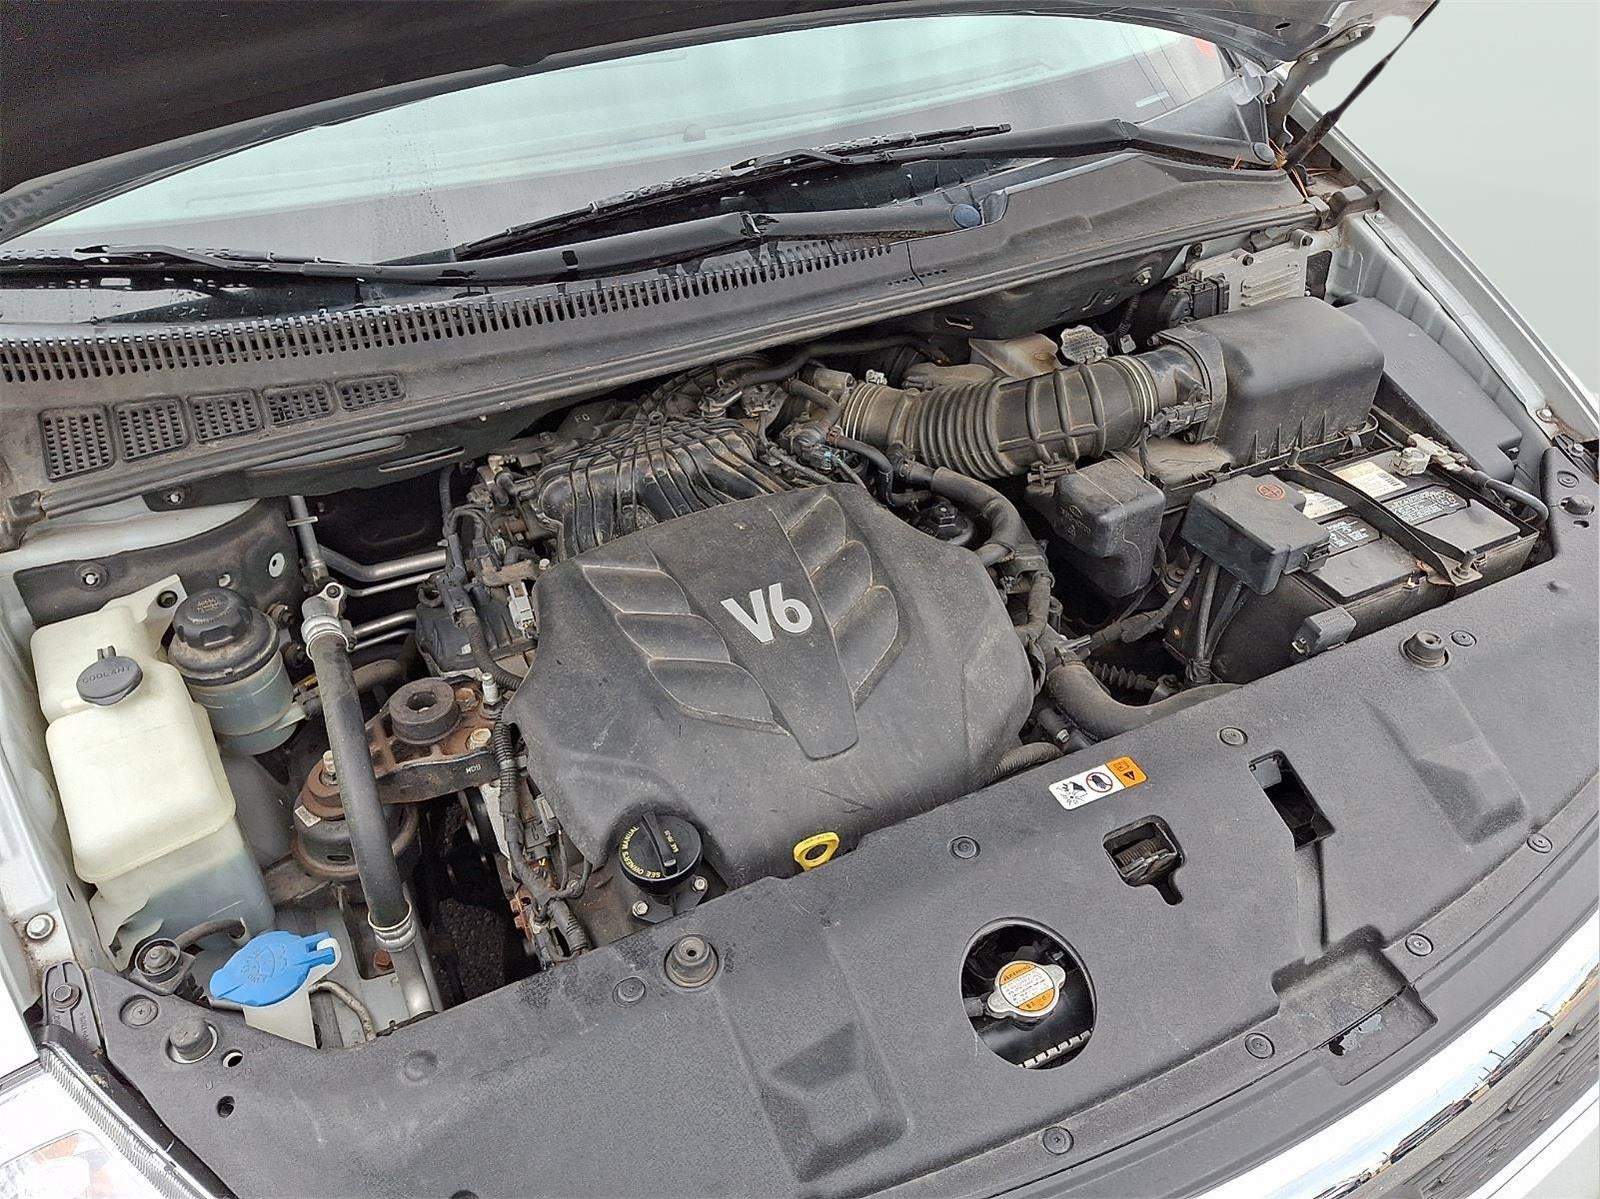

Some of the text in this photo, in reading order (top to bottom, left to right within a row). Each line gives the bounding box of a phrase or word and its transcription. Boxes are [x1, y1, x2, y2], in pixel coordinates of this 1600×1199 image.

[720, 582, 813, 644] V6
[621, 825, 640, 850] MANUAL
[645, 870, 662, 878] SEE
